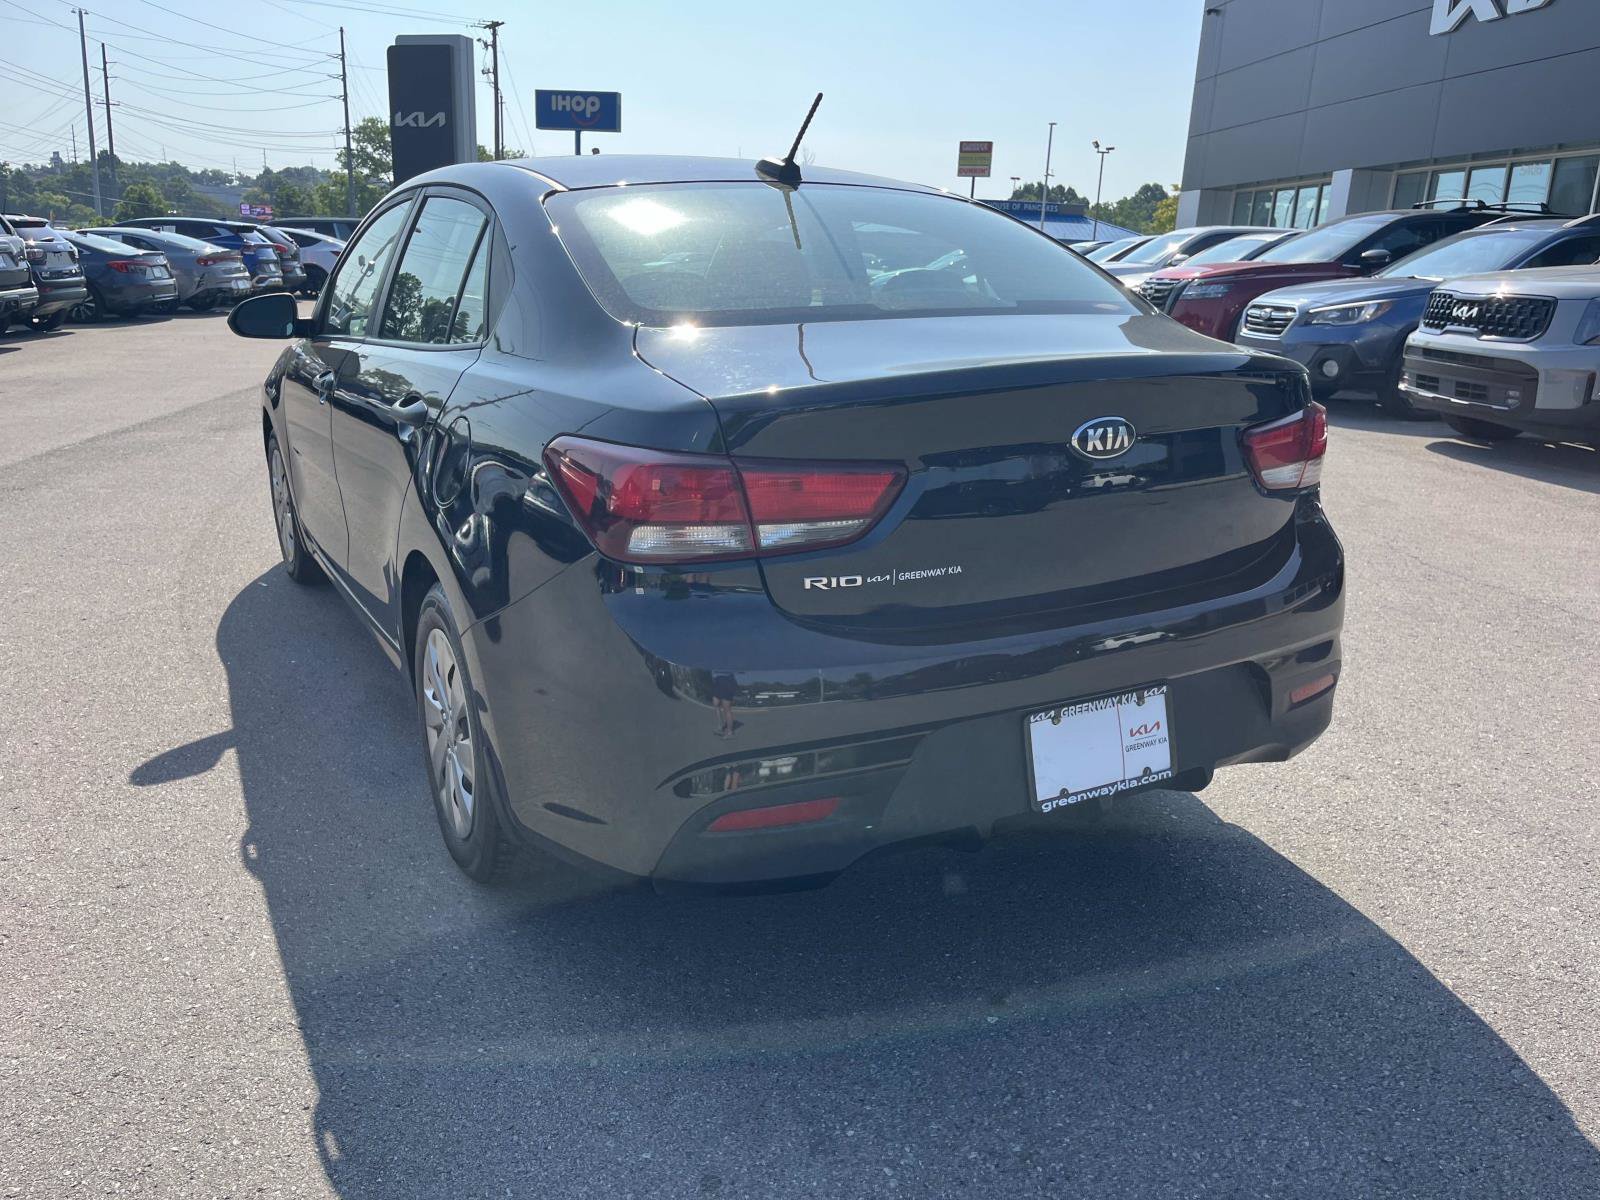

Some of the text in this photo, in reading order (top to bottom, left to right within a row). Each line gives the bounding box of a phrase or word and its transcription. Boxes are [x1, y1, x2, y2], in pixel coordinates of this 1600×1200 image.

[395, 111, 447, 127] KIA
[1452, 306, 1478, 317] KIA
[1087, 425, 1129, 451] KIA
[898, 567, 947, 581] GREENWAY
[948, 565, 962, 574] KIA
[804, 575, 863, 590] RIO
[1060, 696, 1120, 718] GREENWAY
[1121, 692, 1138, 706] KIA
[1129, 720, 1161, 737] KIA
[1125, 736, 1168, 753] GREENWAY KIA
[1041, 769, 1172, 813] greenwaykia.com
